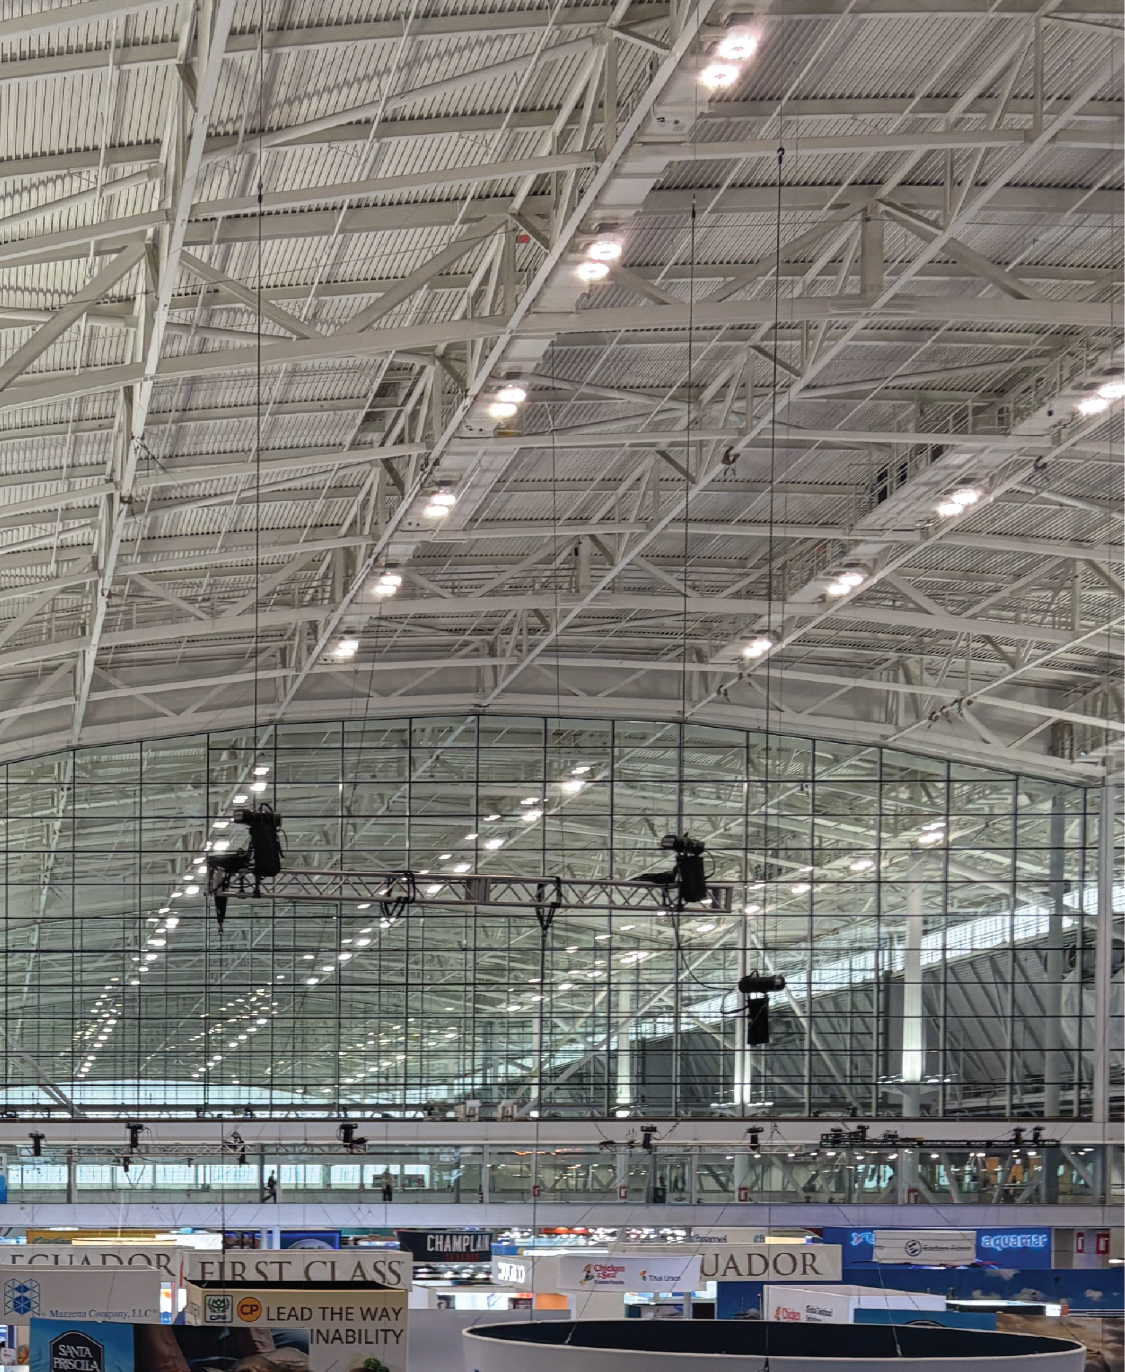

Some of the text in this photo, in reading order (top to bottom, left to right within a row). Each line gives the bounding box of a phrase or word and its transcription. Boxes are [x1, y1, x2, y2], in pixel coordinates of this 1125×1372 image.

[981, 1235, 1048, 1251] aquamar
[198, 1261, 292, 1281] FIRST
[700, 1252, 824, 1277] UADOR
[240, 1304, 404, 1322] CP LEAD THE WAY
[310, 1329, 404, 1345] INABILITY
[58, 1344, 93, 1358] SANTA
[53, 1357, 101, 1372] PRISCILA
